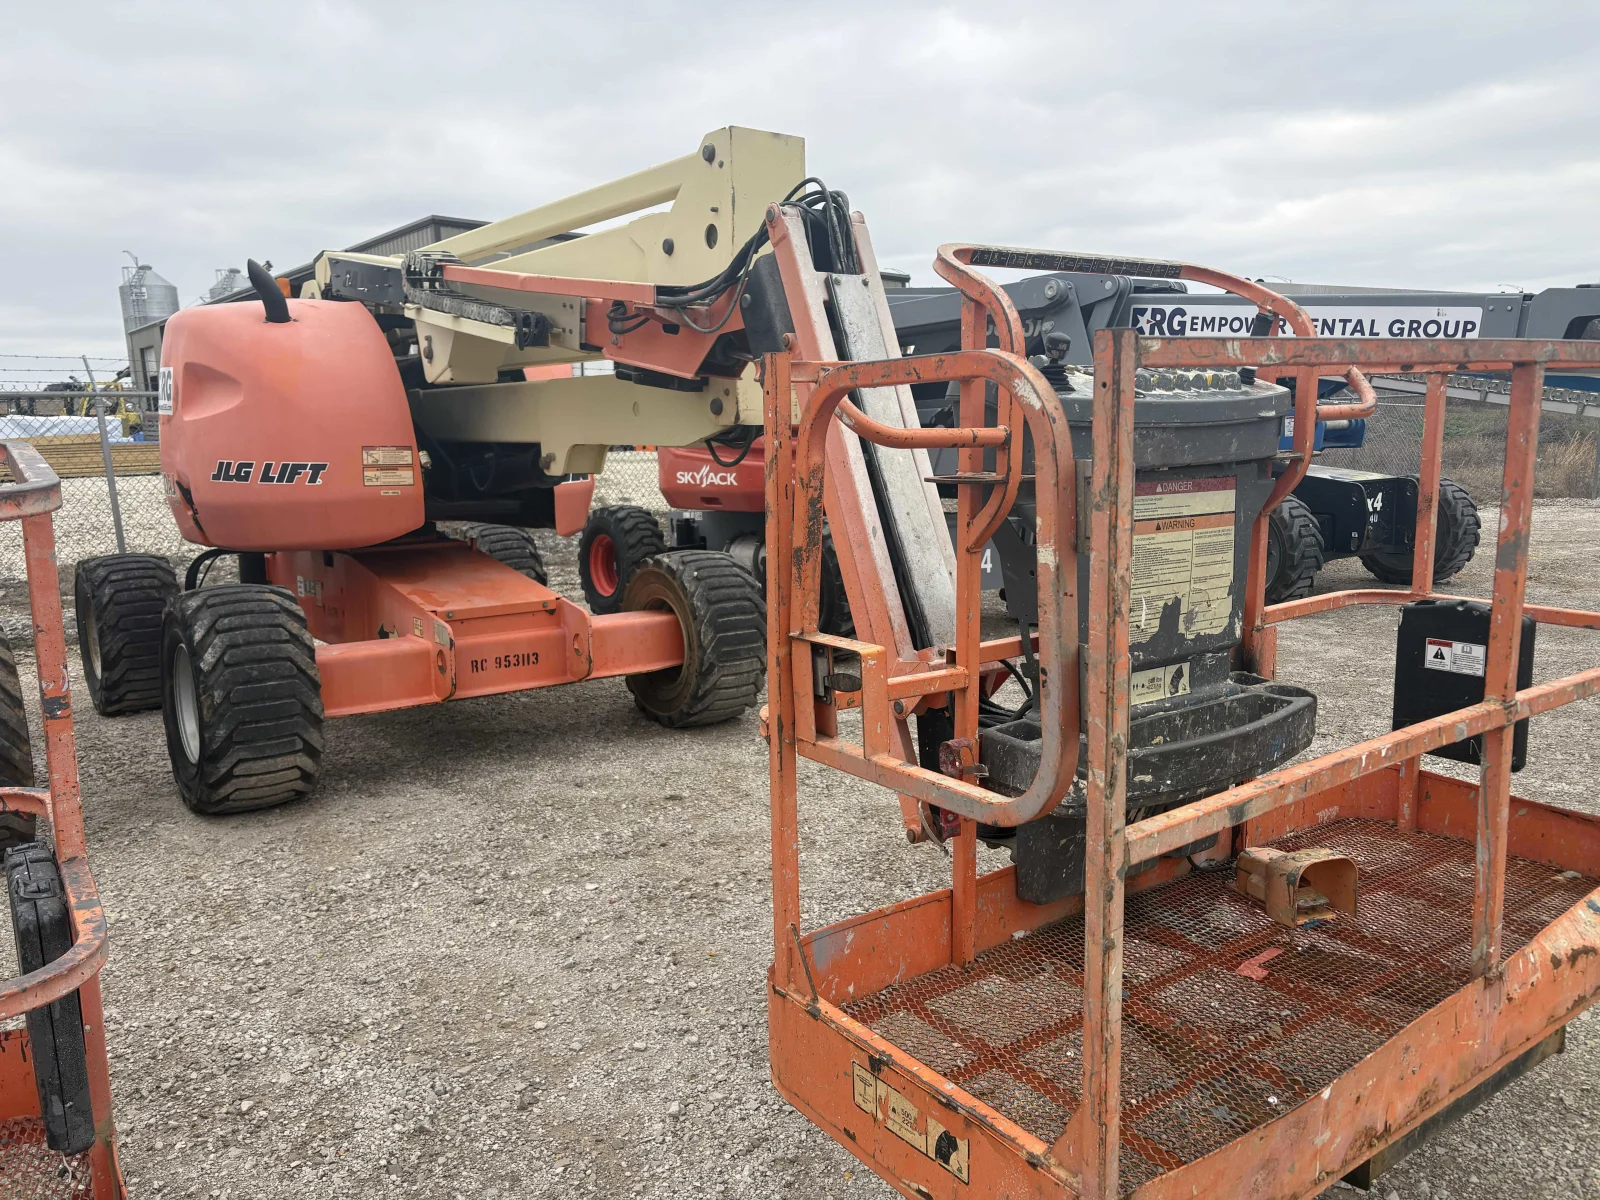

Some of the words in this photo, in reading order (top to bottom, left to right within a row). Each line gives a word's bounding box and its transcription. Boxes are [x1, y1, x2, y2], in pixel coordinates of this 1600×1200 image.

[1388, 319, 1477, 338] GROUP
[211, 460, 255, 483] JLG
[258, 461, 329, 485] LIFT
[676, 464, 738, 488] SKYJACK
[1162, 481, 1193, 492] DANGER
[1161, 518, 1195, 530] WARNING
[470, 658, 488, 673] RC
[494, 651, 540, 670] 953113
